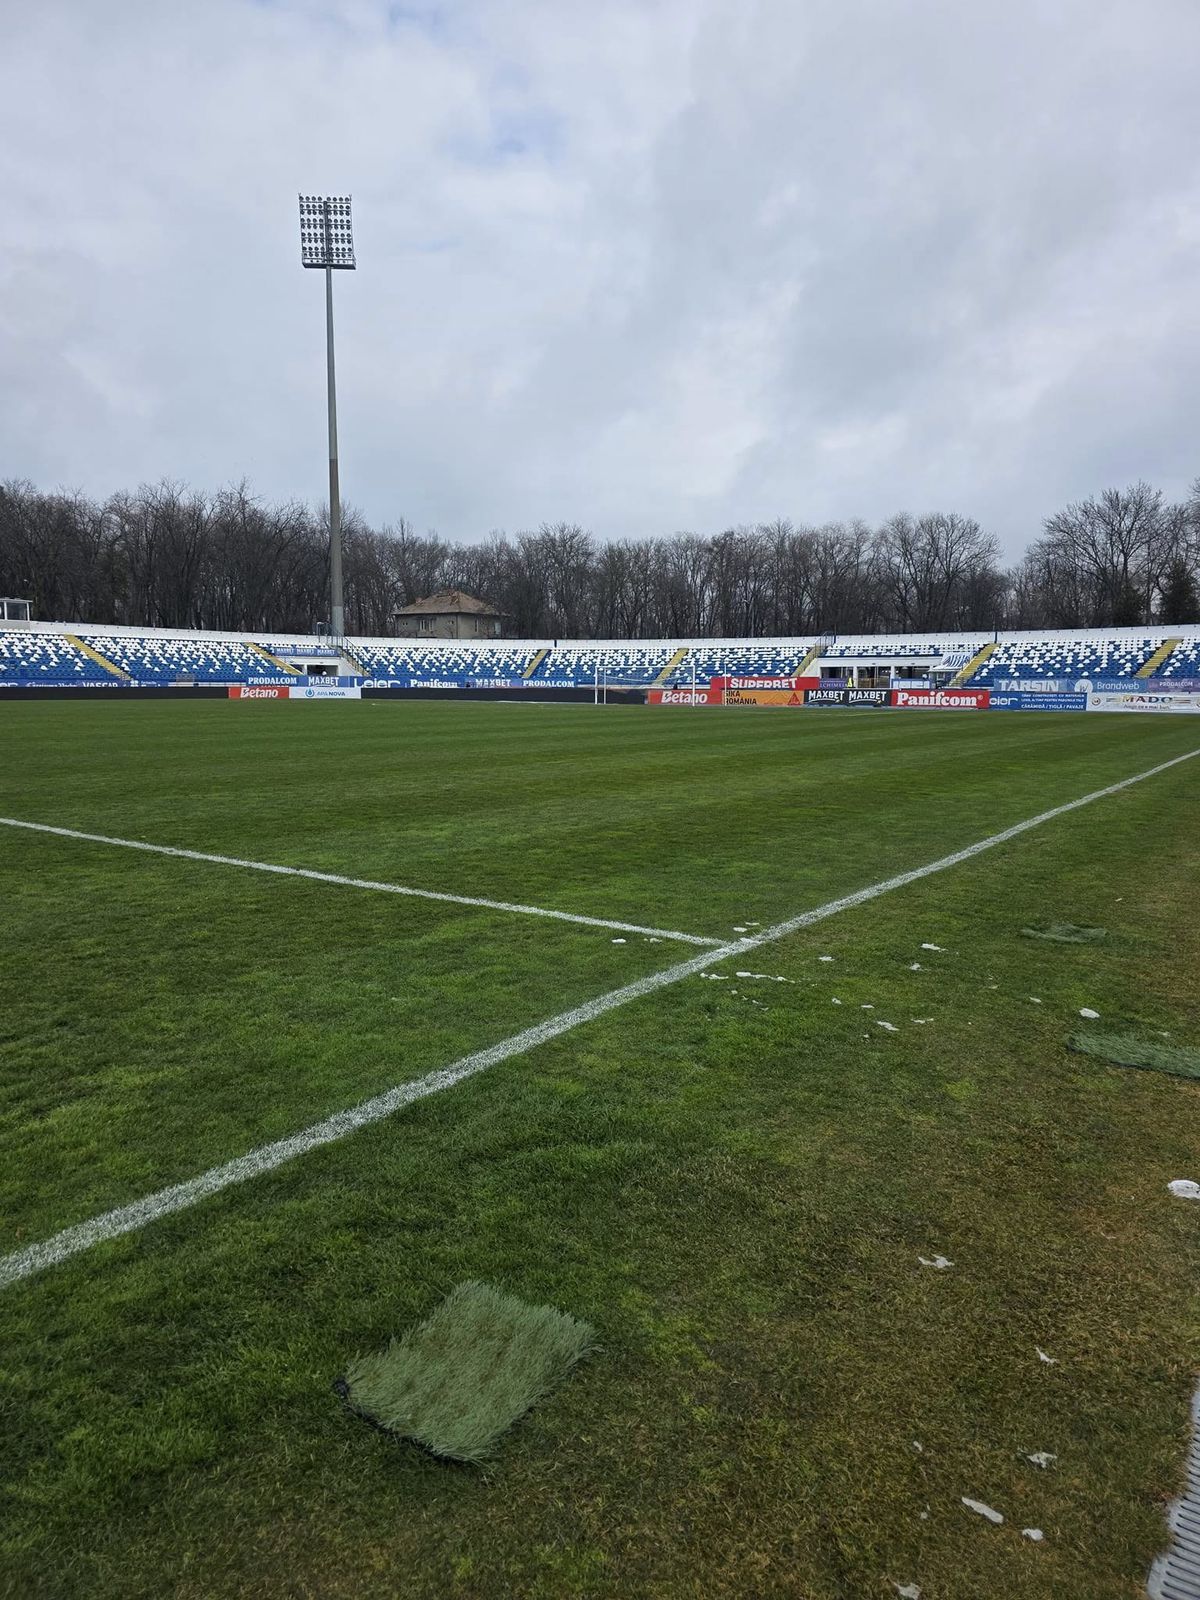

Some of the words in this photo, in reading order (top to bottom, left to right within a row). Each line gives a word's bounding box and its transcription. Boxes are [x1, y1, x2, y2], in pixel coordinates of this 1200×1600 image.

[248, 677, 297, 685] PRODALCOM
[308, 676, 340, 686] MAXBET
[475, 679, 511, 687] MAXBET
[523, 680, 575, 688] PRODALCOM
[998, 680, 1059, 691] TARSIN
[1097, 682, 1140, 690] Brandweb
[240, 687, 279, 698] Betano
[661, 690, 708, 704] Betano
[808, 691, 845, 701] MAXBET
[849, 691, 887, 701] MAXBET
[897, 691, 977, 706] Panifcom
